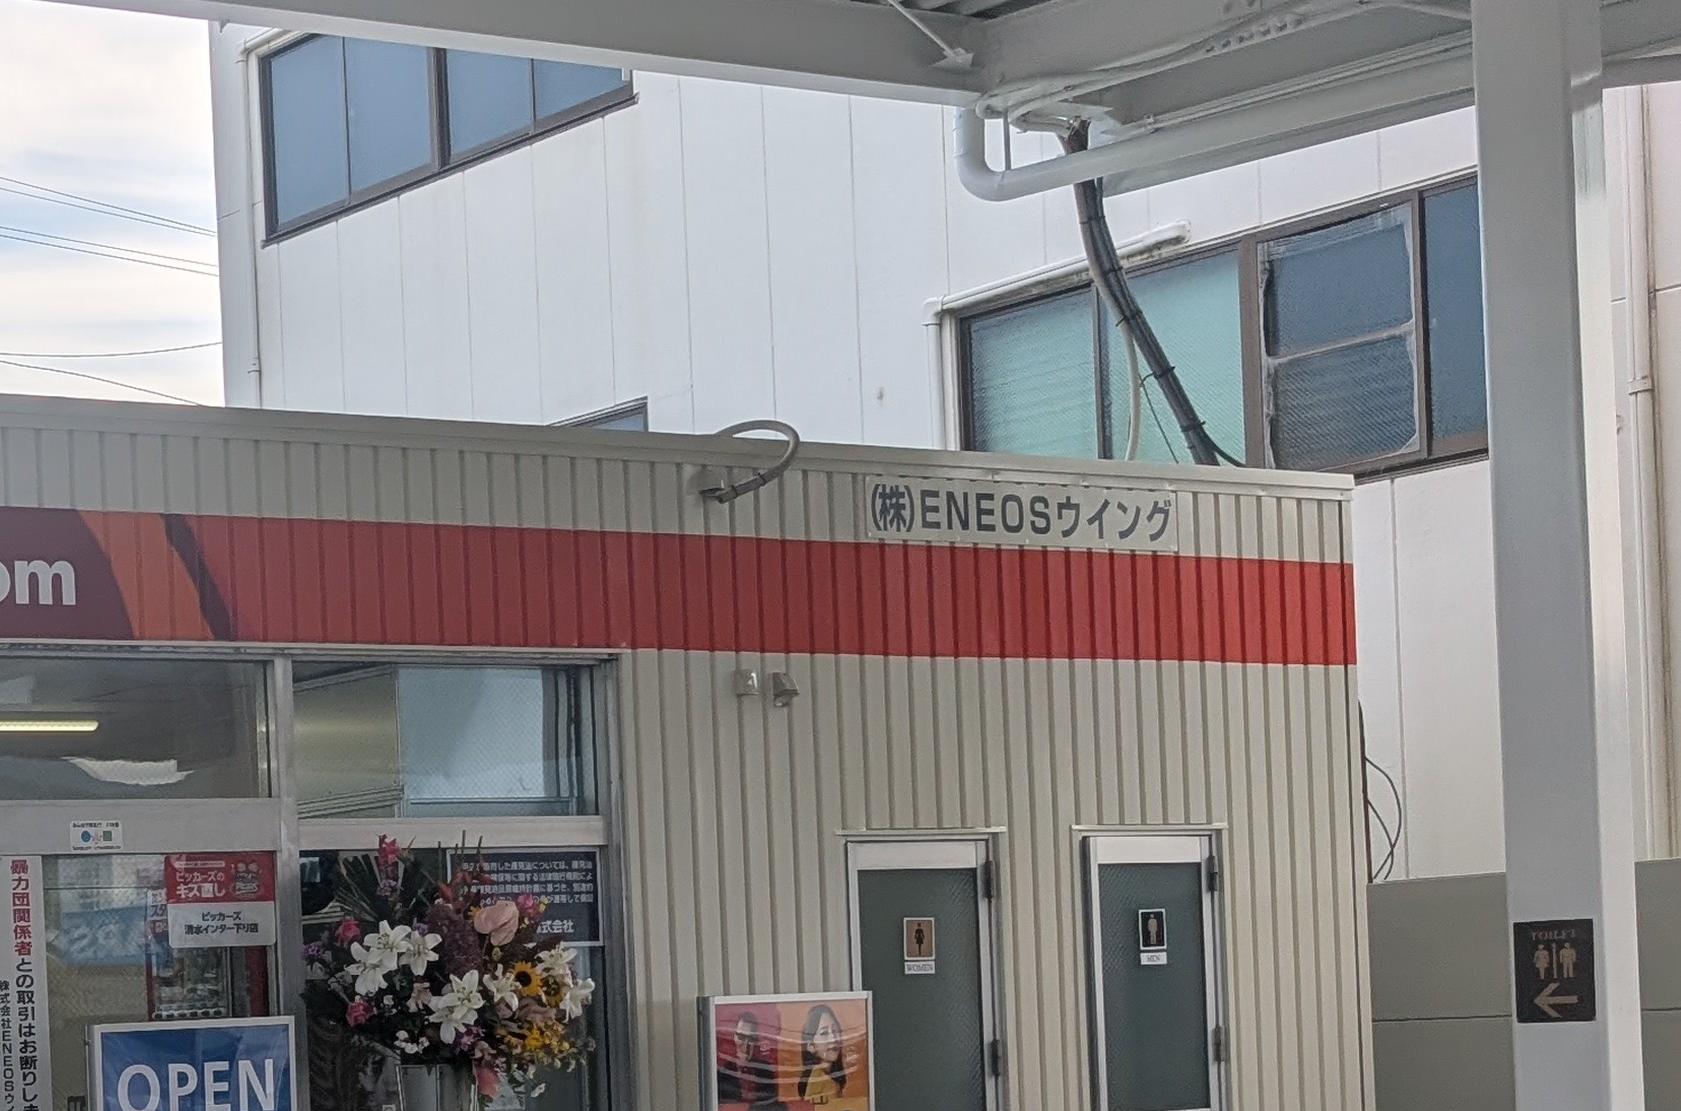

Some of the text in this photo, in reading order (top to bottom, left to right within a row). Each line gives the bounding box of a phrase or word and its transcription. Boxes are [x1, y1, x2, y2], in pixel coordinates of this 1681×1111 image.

[871, 483, 1171, 543] (株)ENEOSウイング
